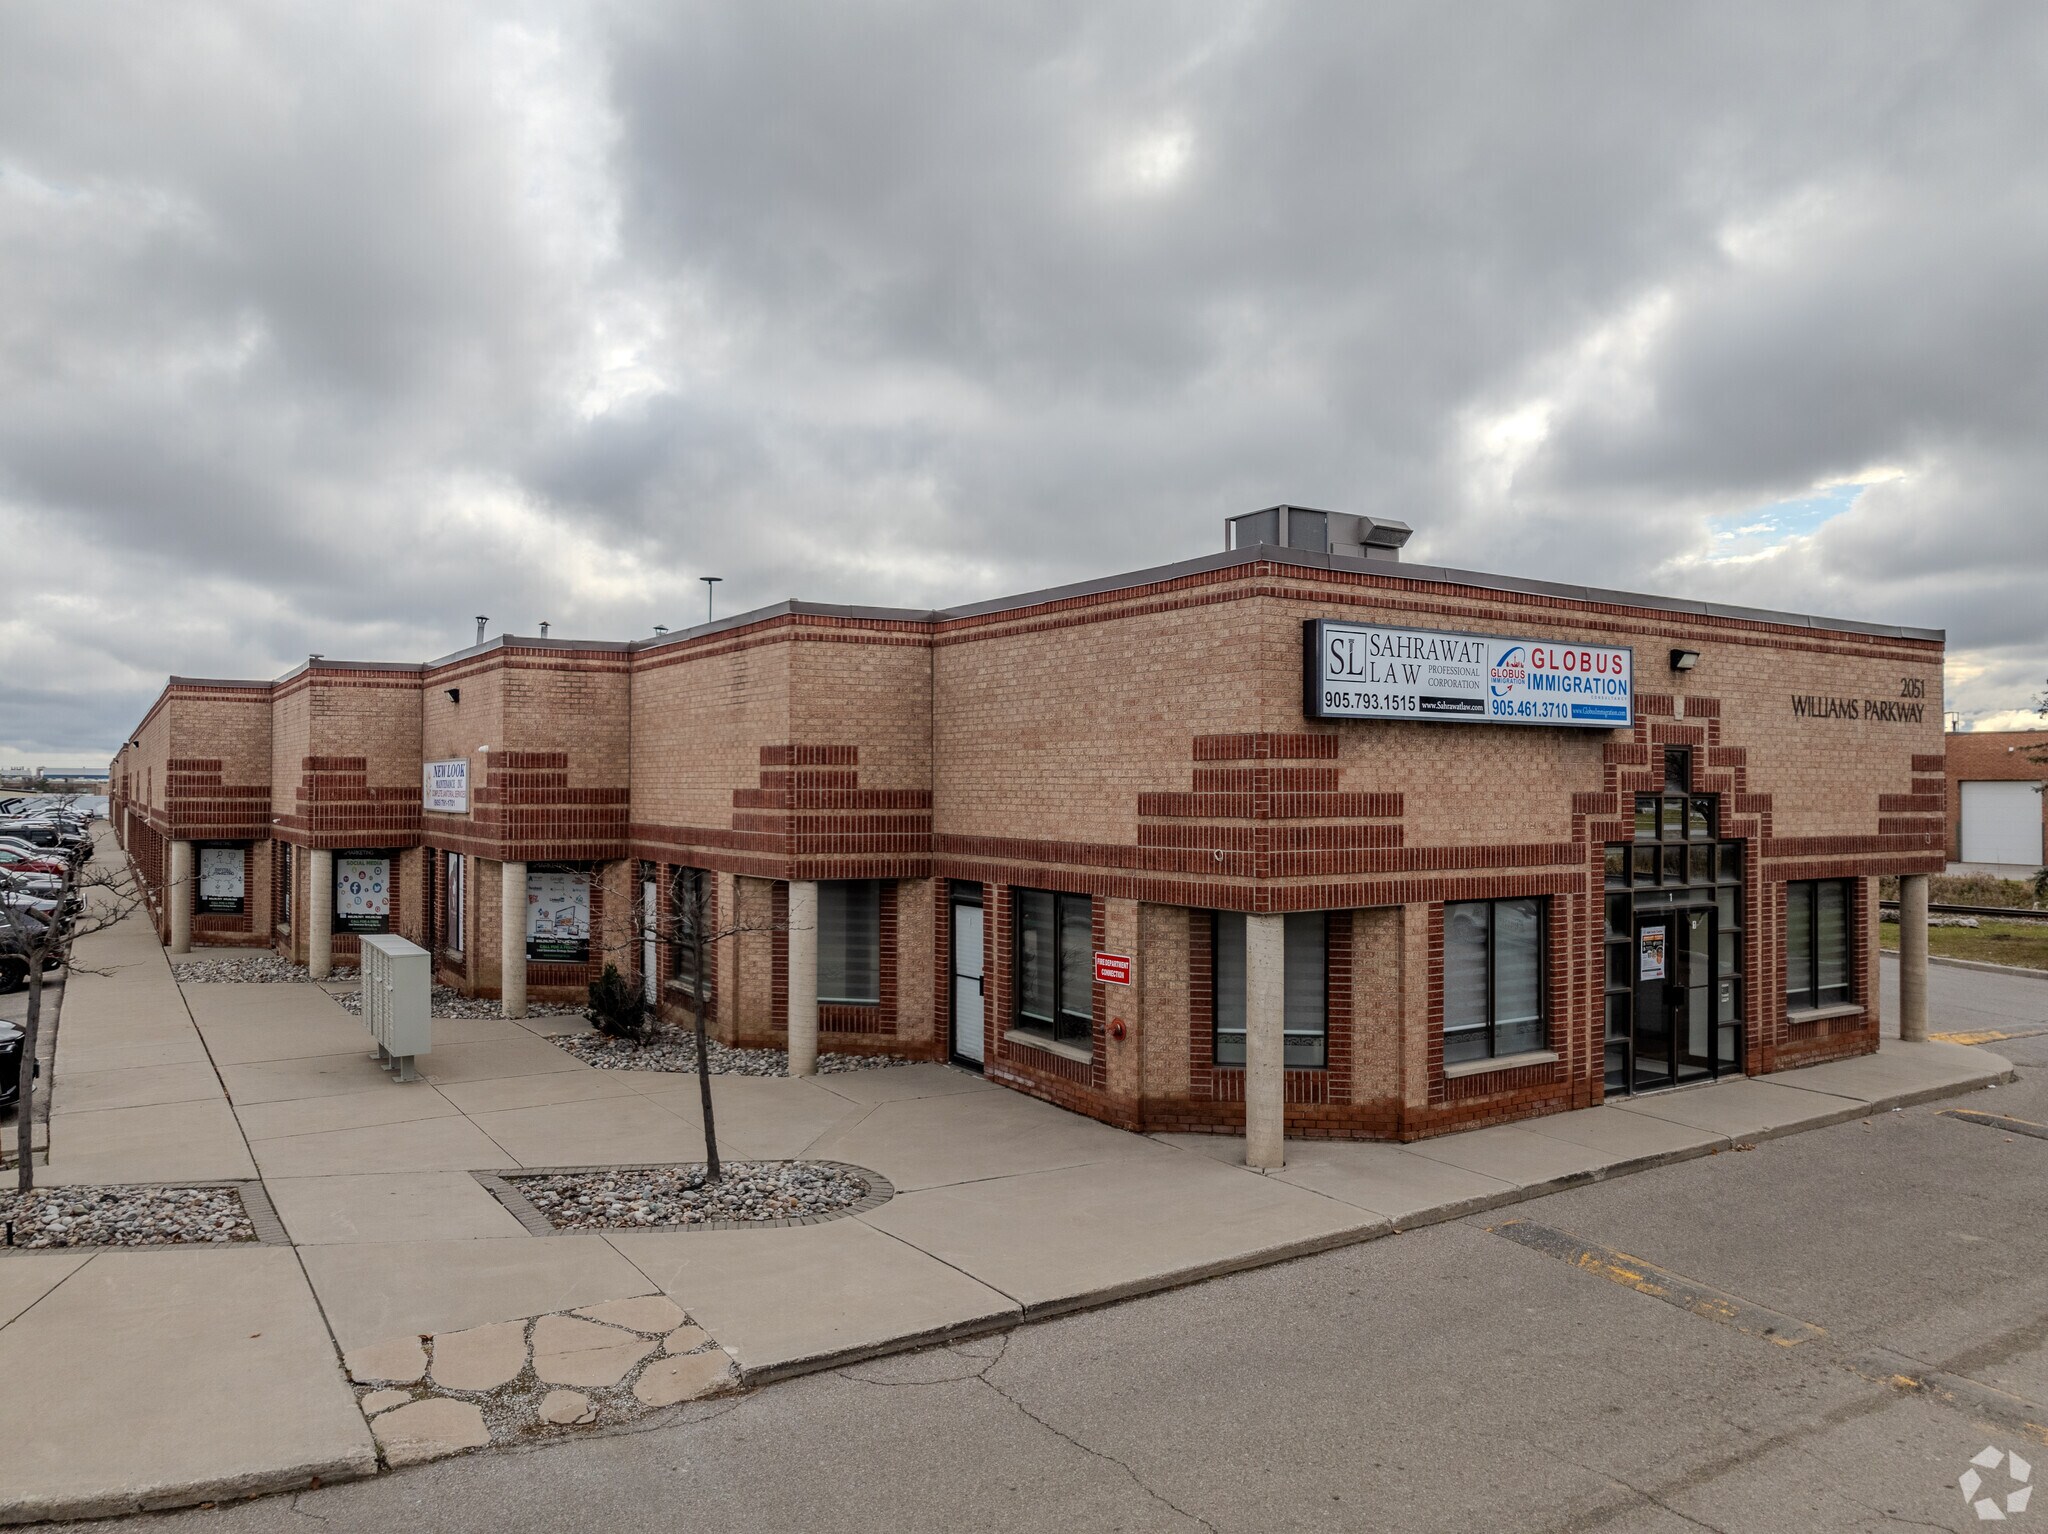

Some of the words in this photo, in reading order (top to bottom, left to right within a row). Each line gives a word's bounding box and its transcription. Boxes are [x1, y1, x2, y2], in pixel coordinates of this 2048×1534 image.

[1330, 638, 1364, 675] SL
[1370, 633, 1484, 664] SAHRAWAT
[1428, 664, 1480, 677] PROFESSIONAL
[1531, 648, 1623, 675] GLOBUS
[1370, 662, 1421, 685] LAW
[1428, 678, 1480, 690] CORPORATION
[1490, 668, 1526, 679] GLOBUS
[1527, 673, 1628, 696] IMMIGRATION
[1900, 678, 1925, 699] 2051
[1325, 691, 1416, 712] 905.793.1515
[1492, 699, 1568, 718] 905.461.3710
[1791, 695, 1859, 720] WILLIAMS
[1864, 699, 1925, 723] PARKWAY
[433, 764, 447, 778] NEW
[447, 763, 466, 778] LOOK
[1669, 892, 1673, 902] 1
